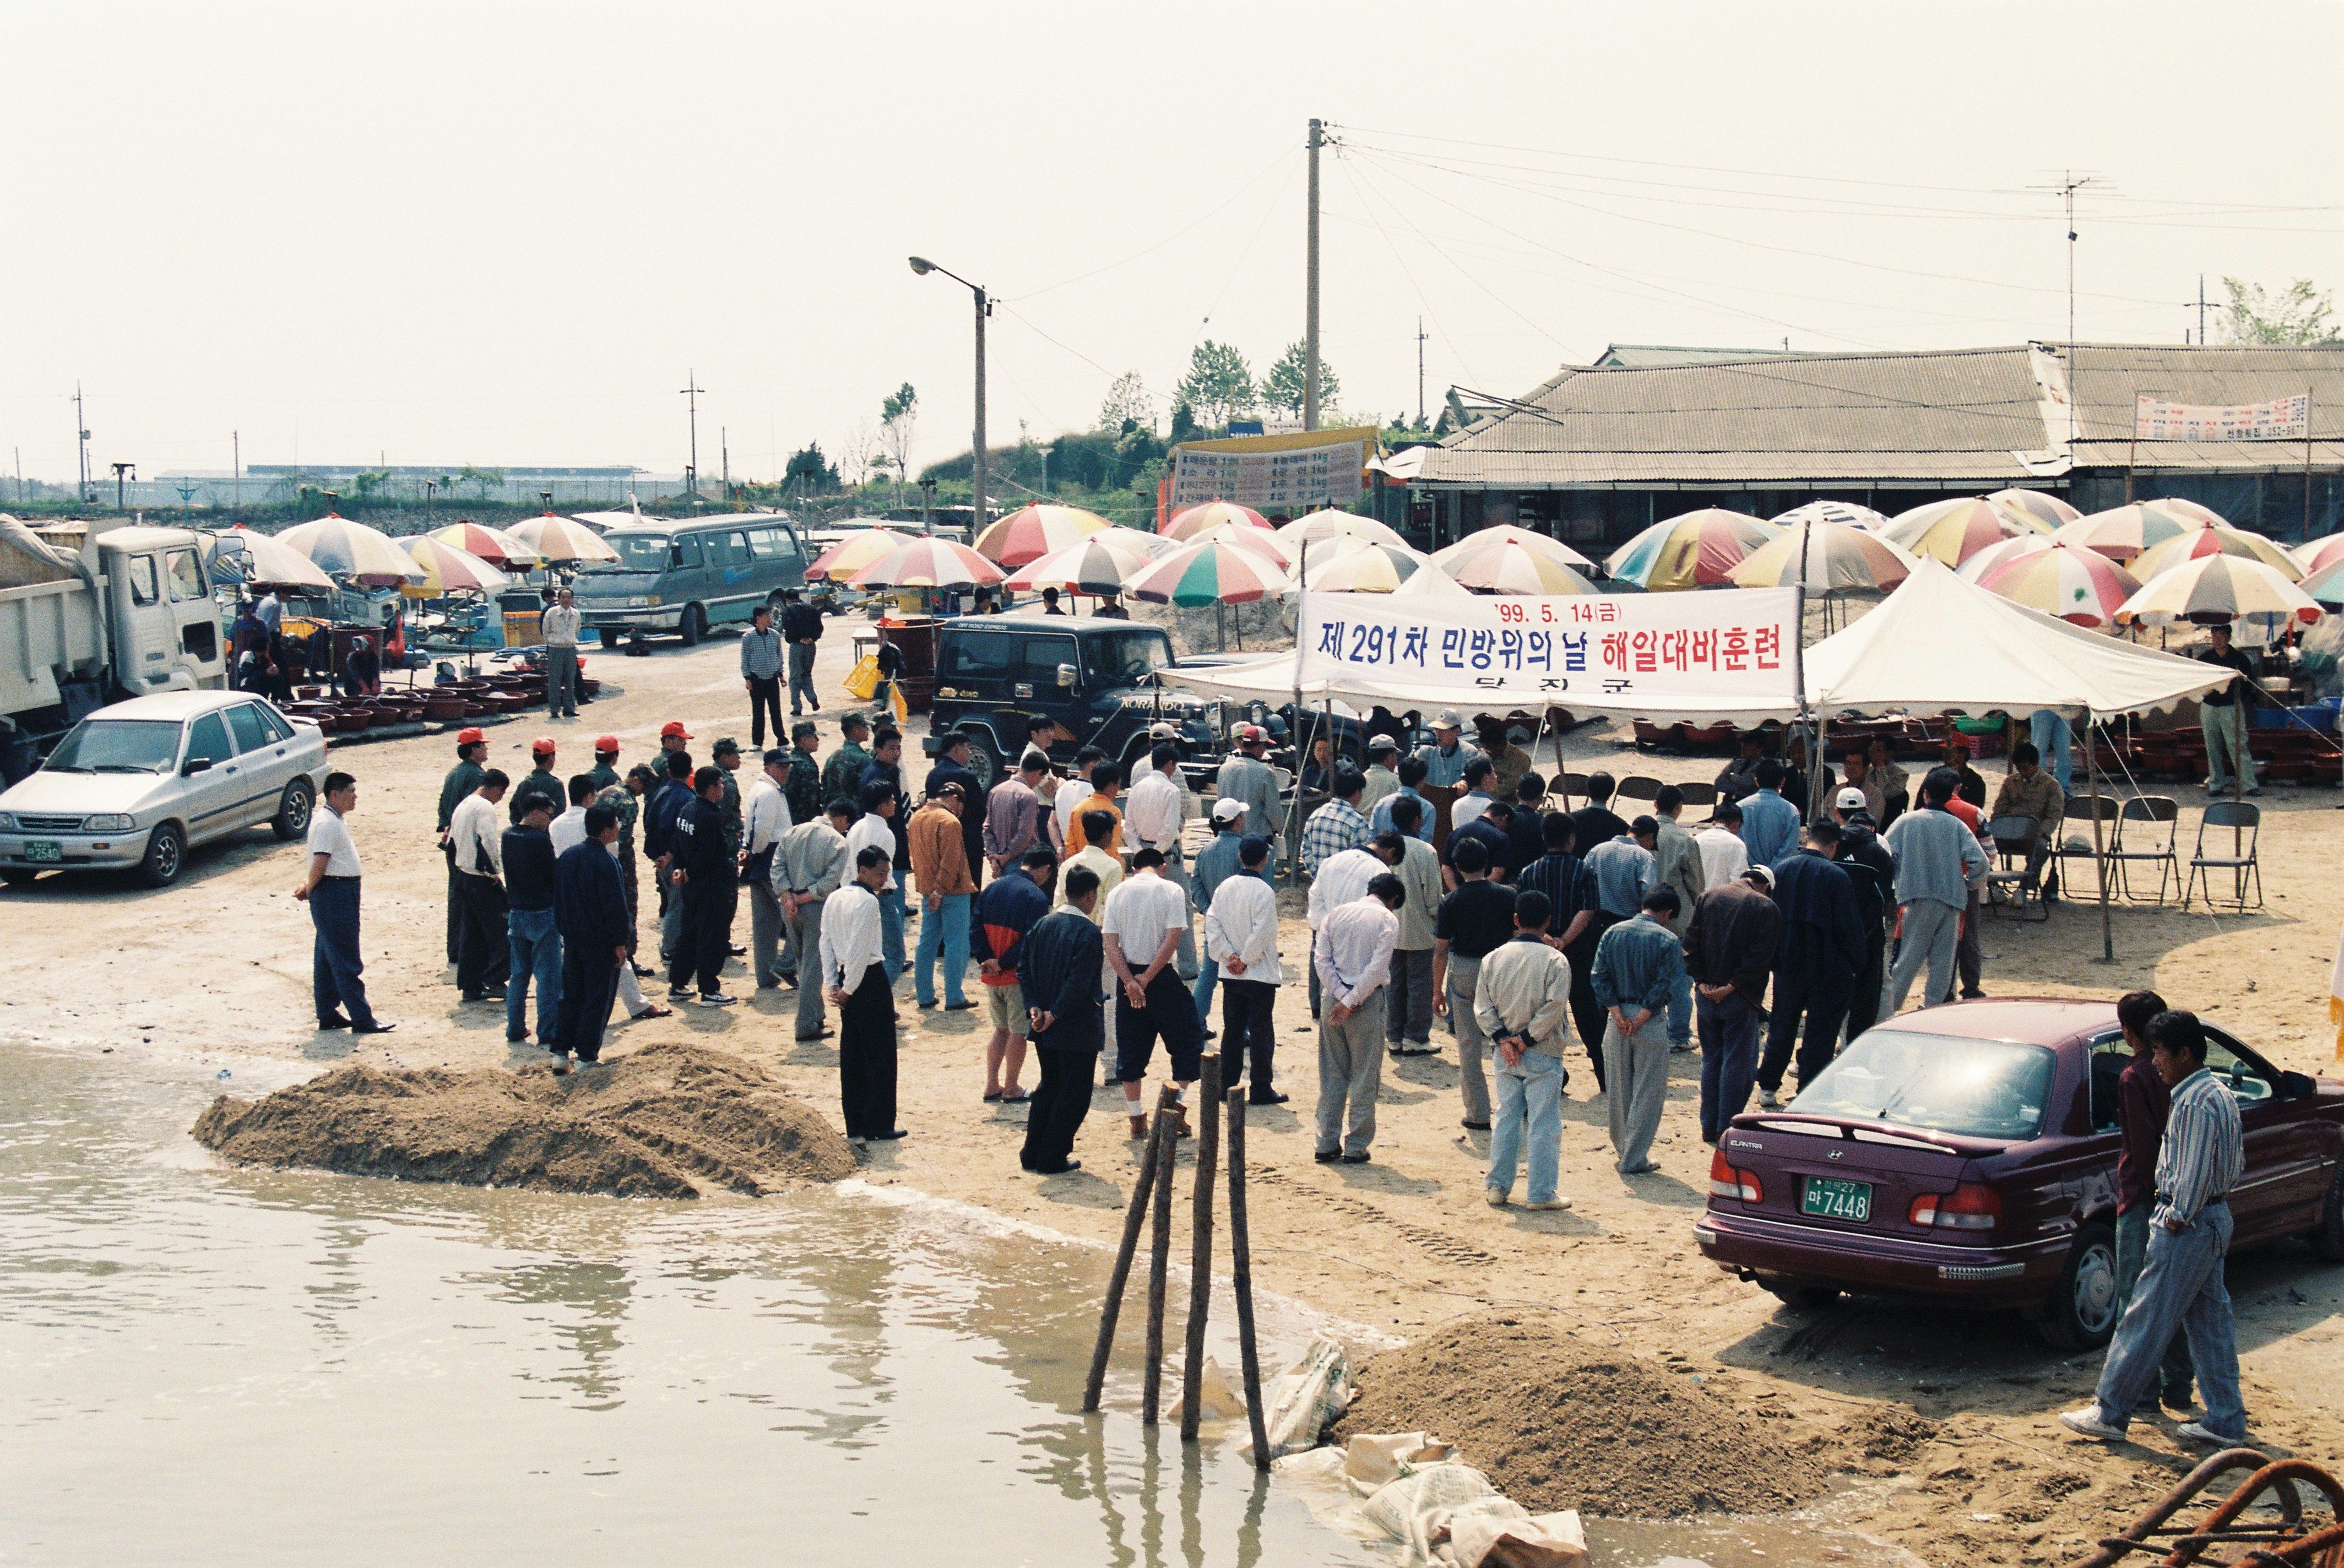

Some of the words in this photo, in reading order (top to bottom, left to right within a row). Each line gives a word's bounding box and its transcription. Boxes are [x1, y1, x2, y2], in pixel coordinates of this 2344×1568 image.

[1541, 604, 1559, 623] 5.
[1441, 627, 1552, 671] 민방위의
[1561, 631, 1588, 671] 날
[1601, 623, 1779, 672] 해일대비훈련
[1730, 1140, 1762, 1149] ELANTRA
